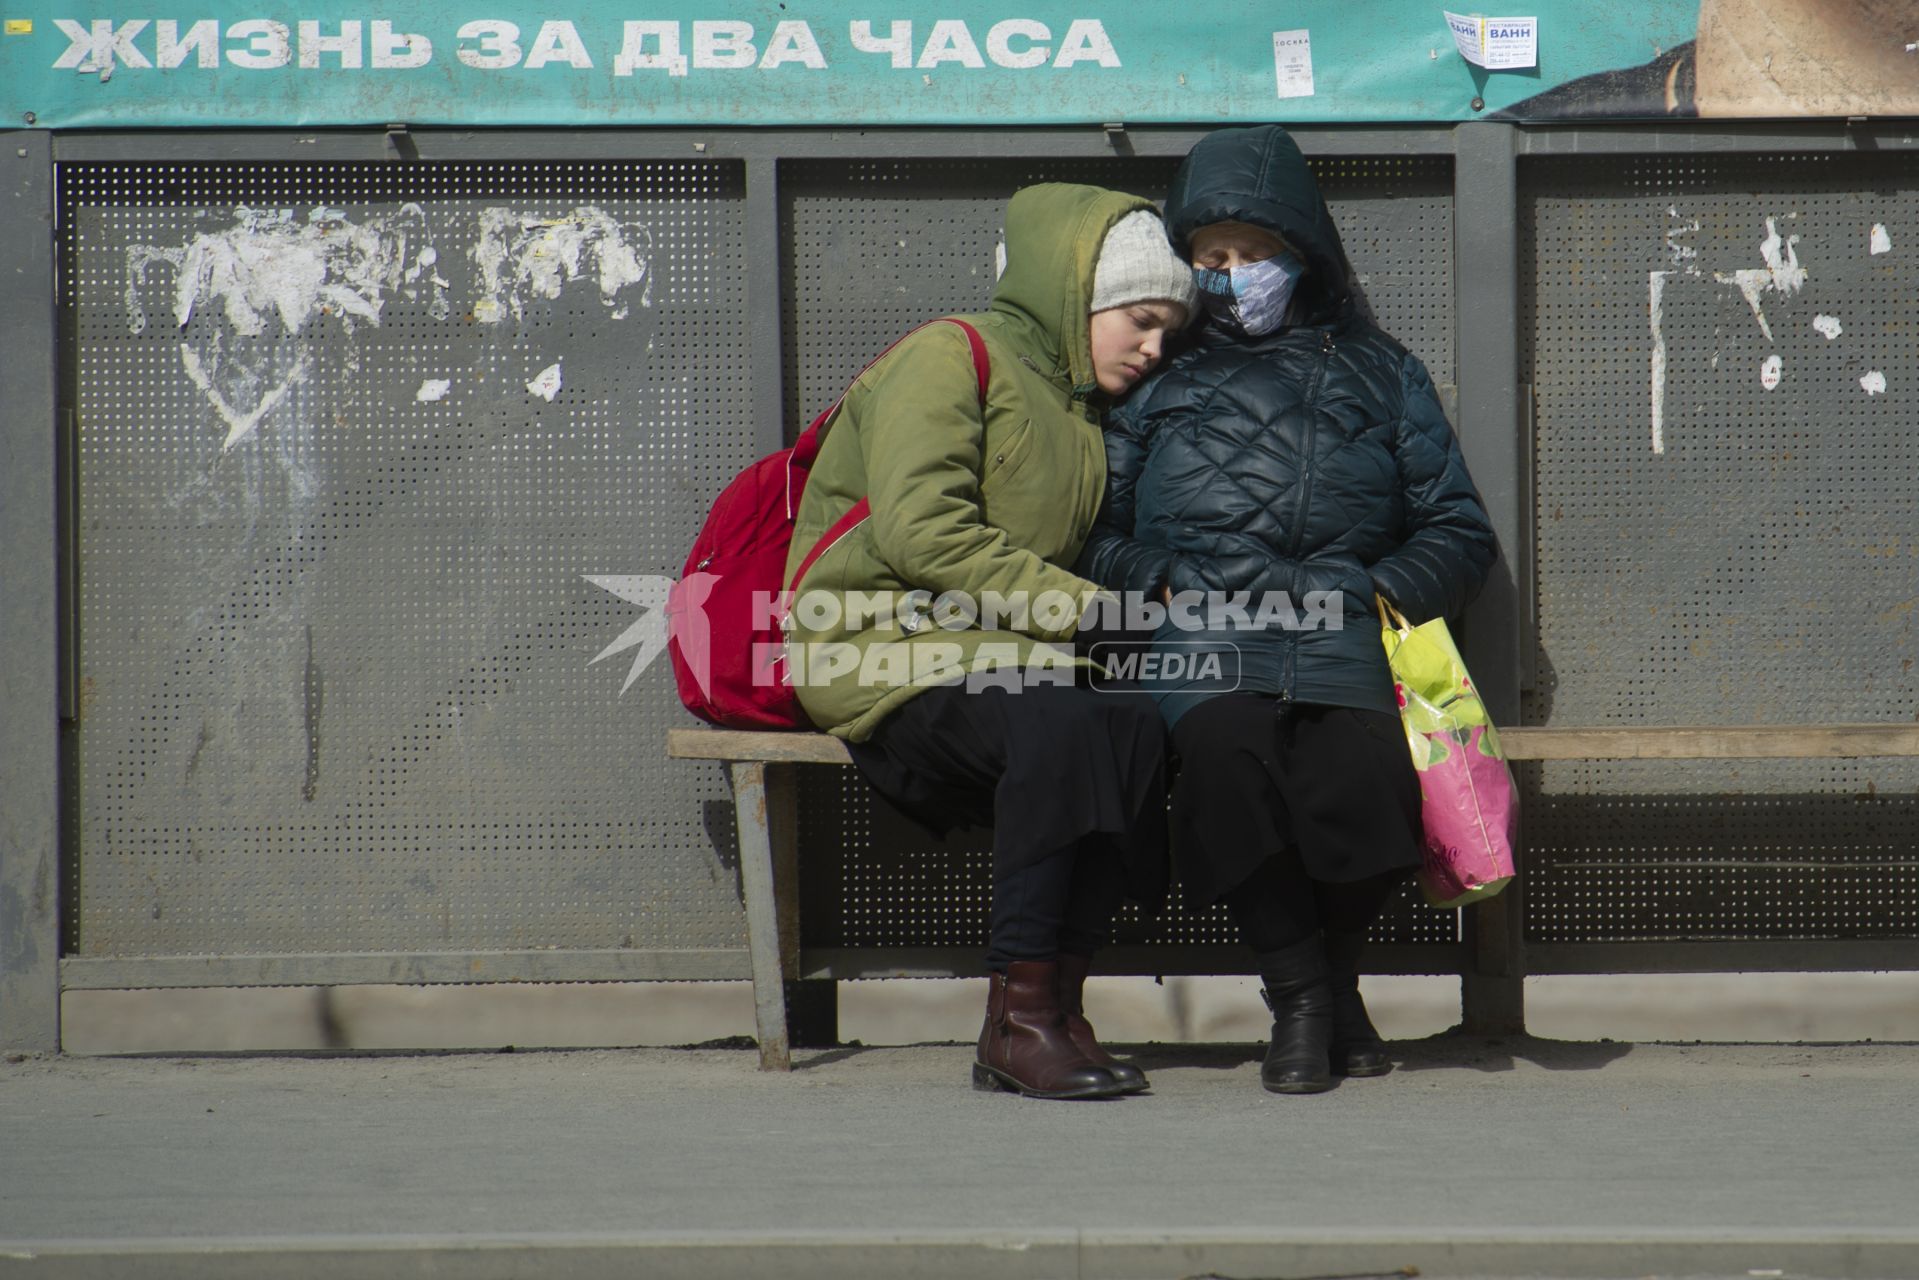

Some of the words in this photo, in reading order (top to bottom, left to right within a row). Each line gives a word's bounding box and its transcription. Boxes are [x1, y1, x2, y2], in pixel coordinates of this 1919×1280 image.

[52, 19, 432, 70] ЖИЗНЬ
[456, 19, 594, 69] ЗА
[615, 20, 828, 76] ДВА
[850, 19, 1122, 68] ЧАСА
[1490, 28, 1530, 38] ВАНН
